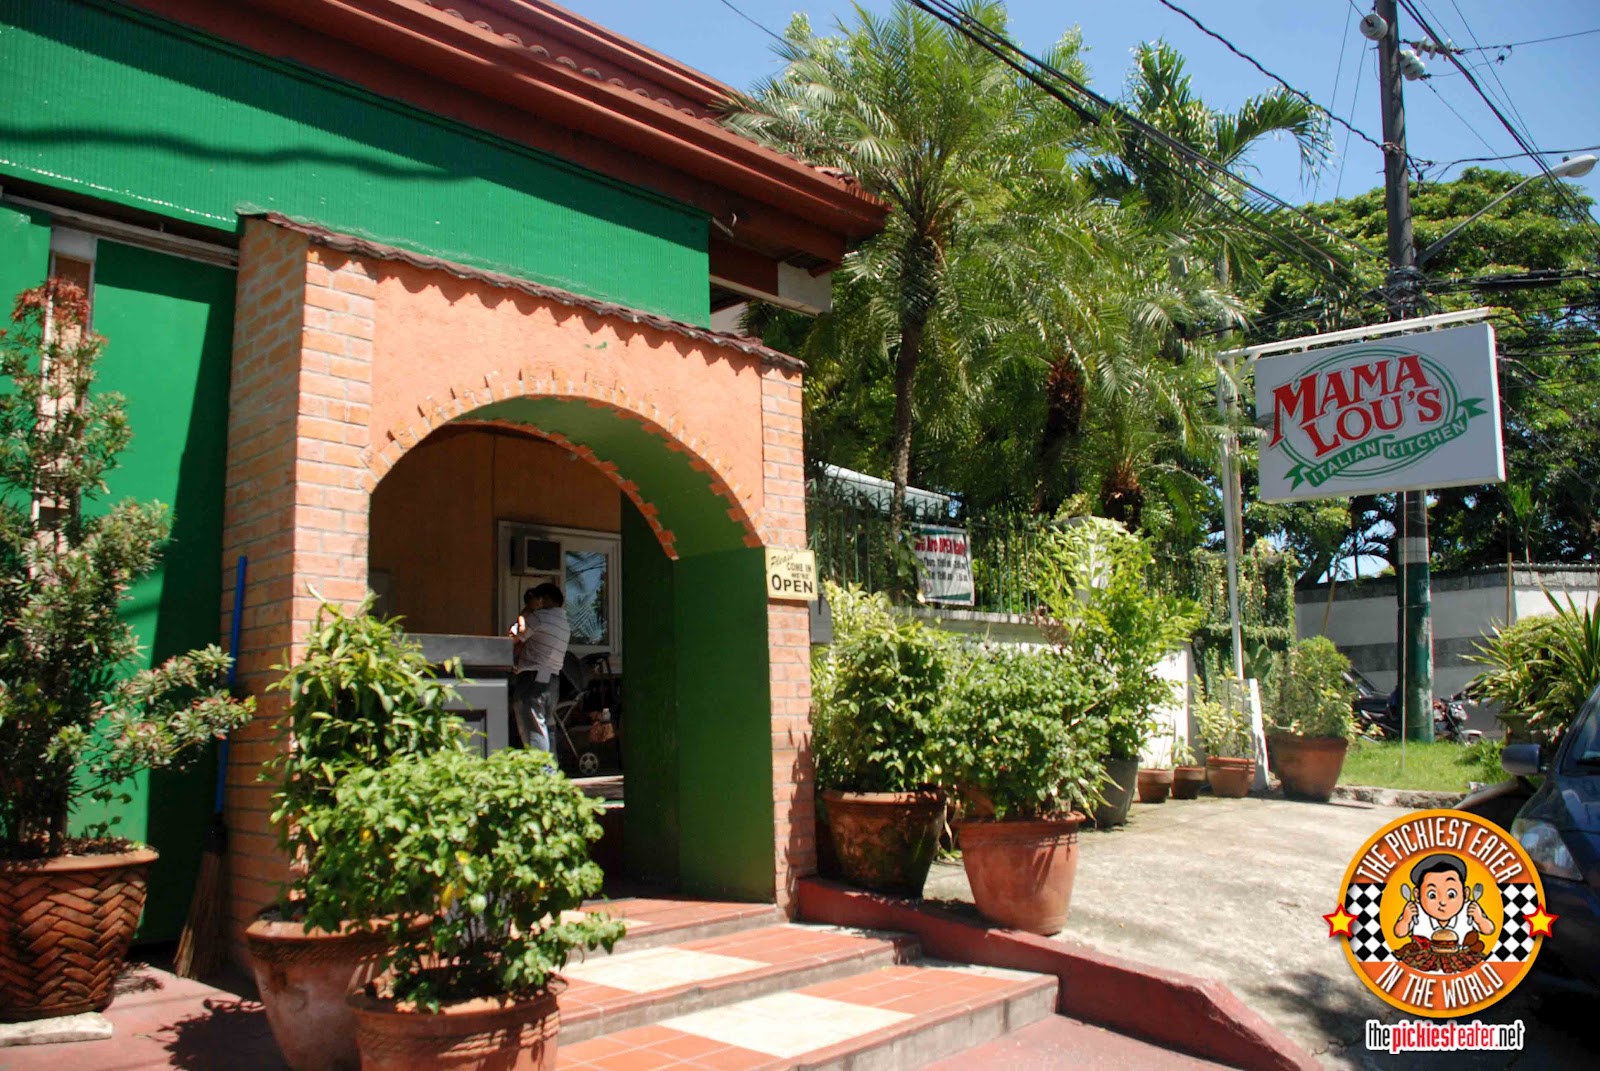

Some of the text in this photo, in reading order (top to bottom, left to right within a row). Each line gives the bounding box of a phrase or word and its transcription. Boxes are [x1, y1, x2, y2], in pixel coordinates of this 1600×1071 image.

[1268, 354, 1432, 448] MAMA
[1302, 388, 1443, 458] LOU'S
[1308, 418, 1466, 483] ITALIAN KITCHEN
[939, 536, 954, 554] OPEN
[770, 553, 794, 567] Please
[786, 562, 812, 572] COME IN
[772, 574, 813, 593] OPEN
[791, 572, 810, 580] WE'RE
